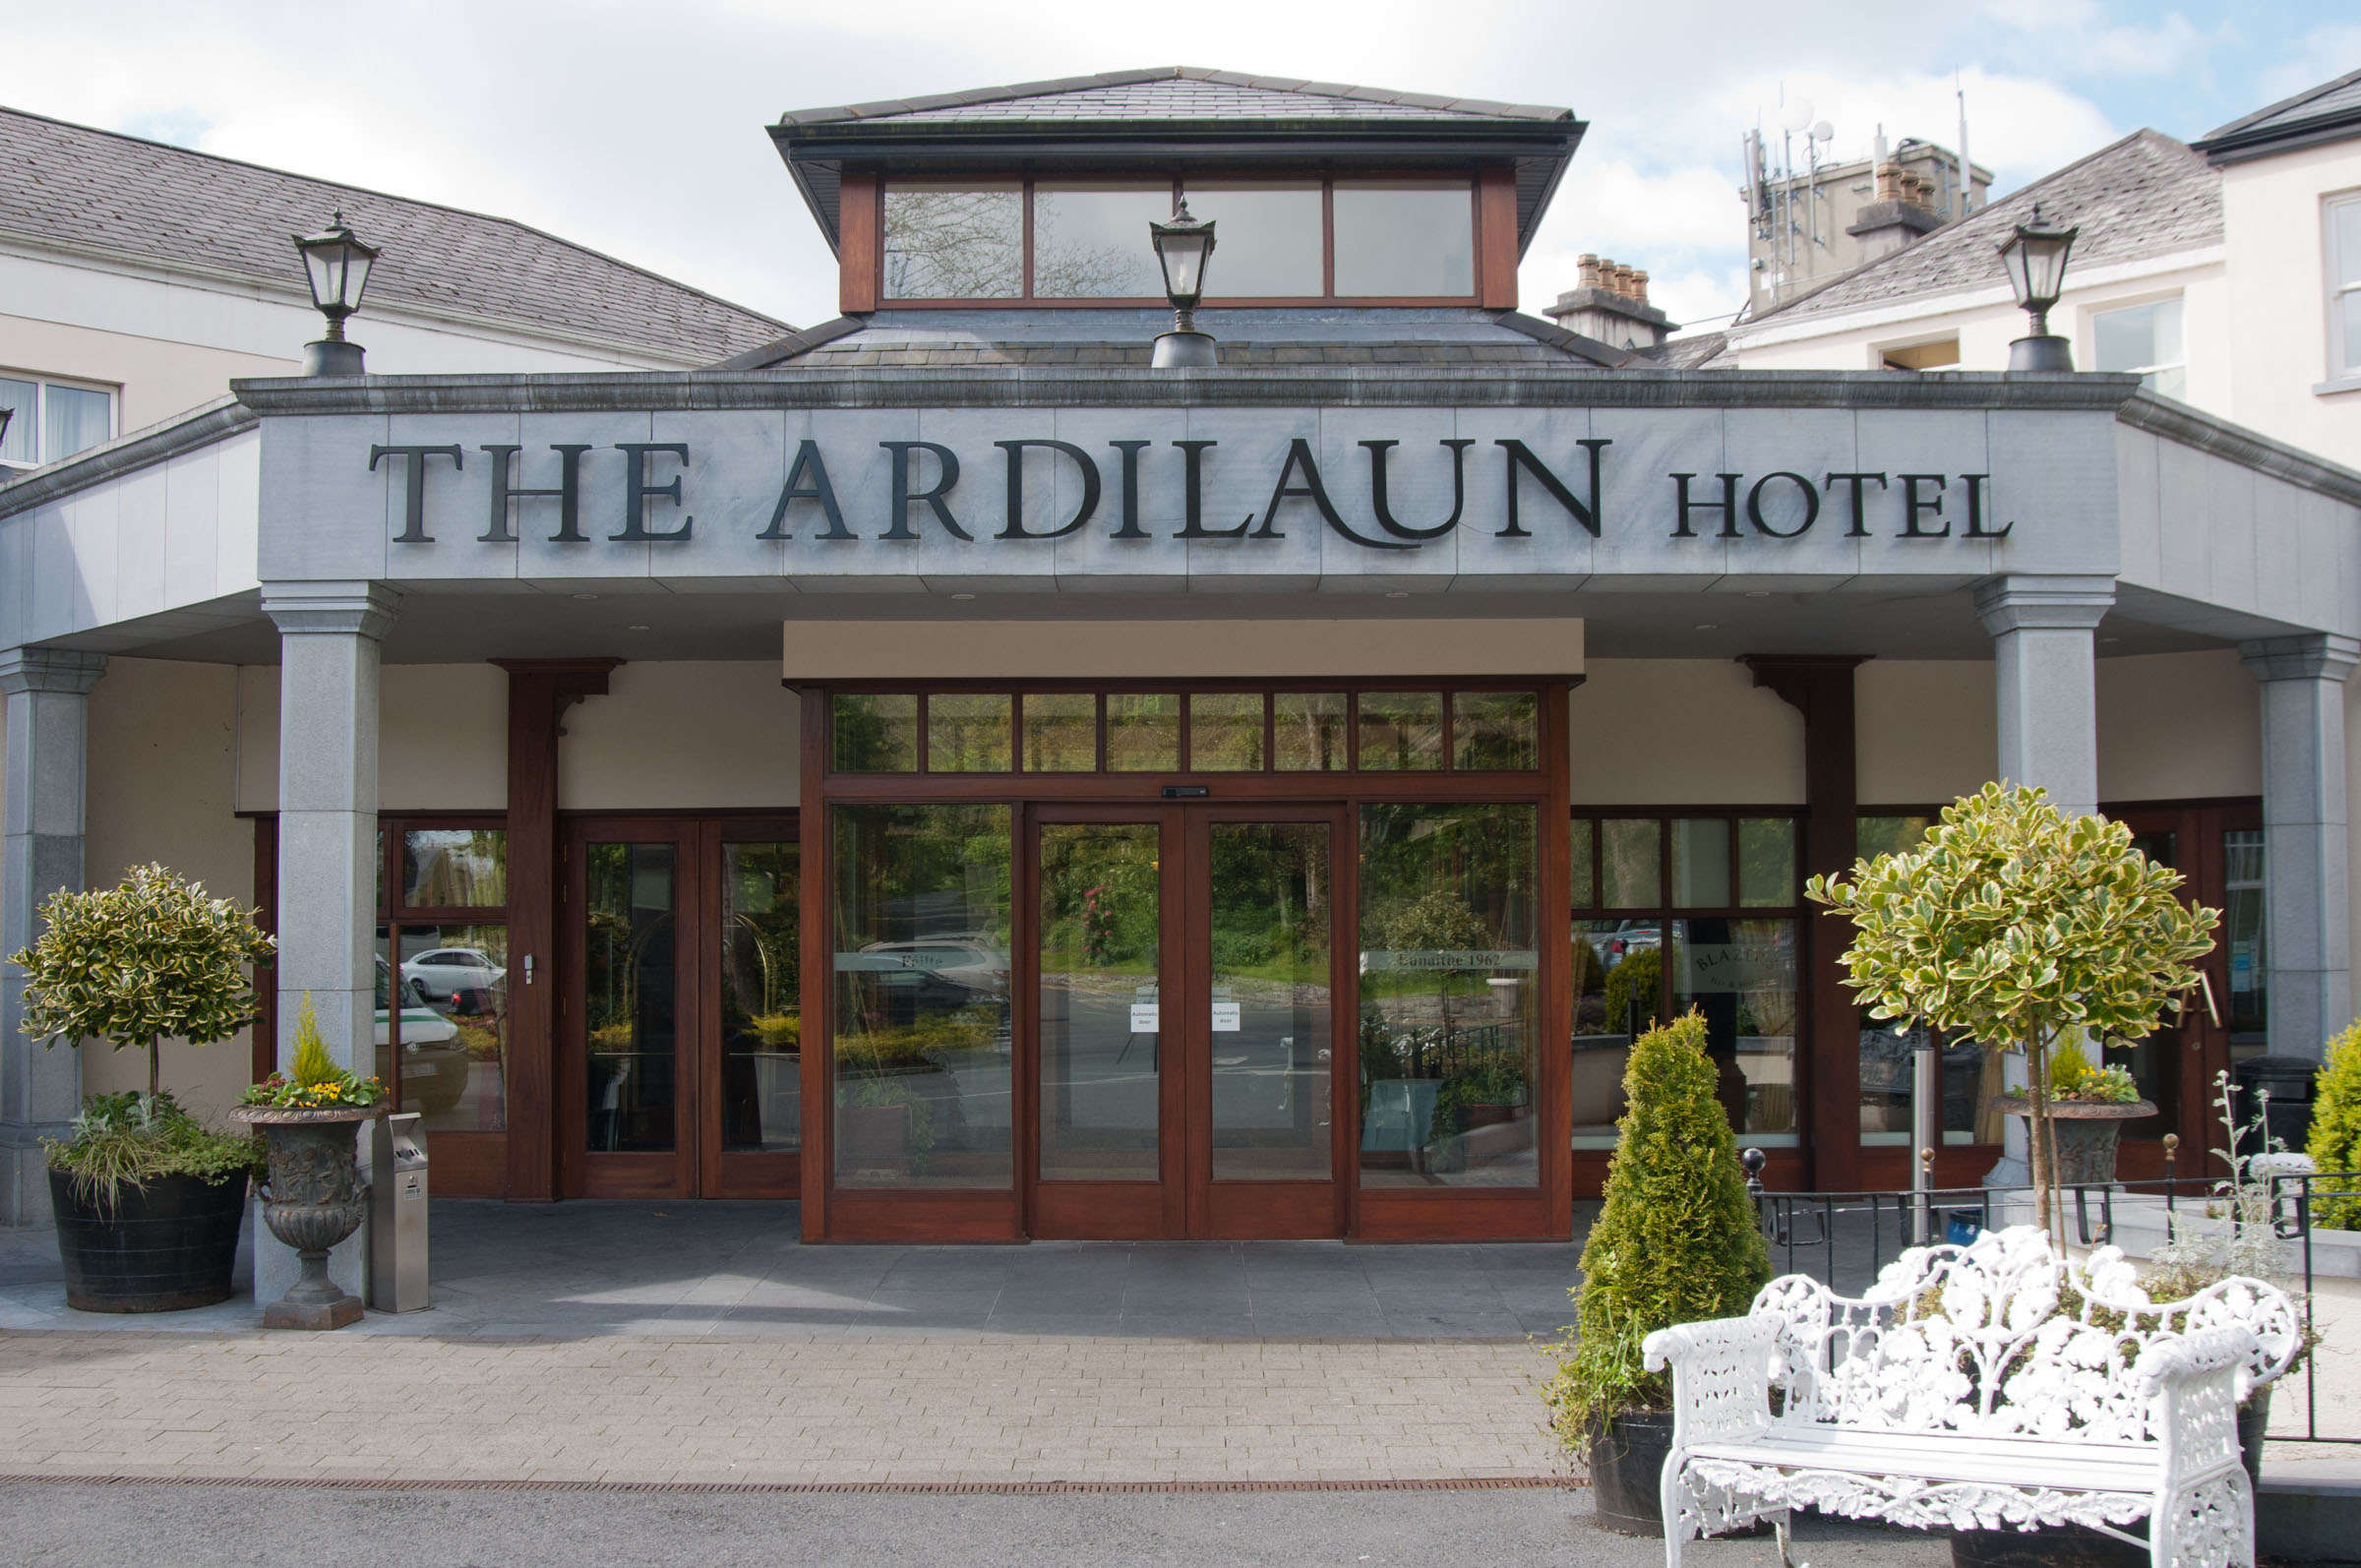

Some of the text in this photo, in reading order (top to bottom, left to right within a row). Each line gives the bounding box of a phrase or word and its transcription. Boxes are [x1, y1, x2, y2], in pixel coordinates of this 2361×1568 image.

[369, 439, 2015, 549] THE ARDILAUN HOTEL
[1469, 953, 1501, 966] 1962
